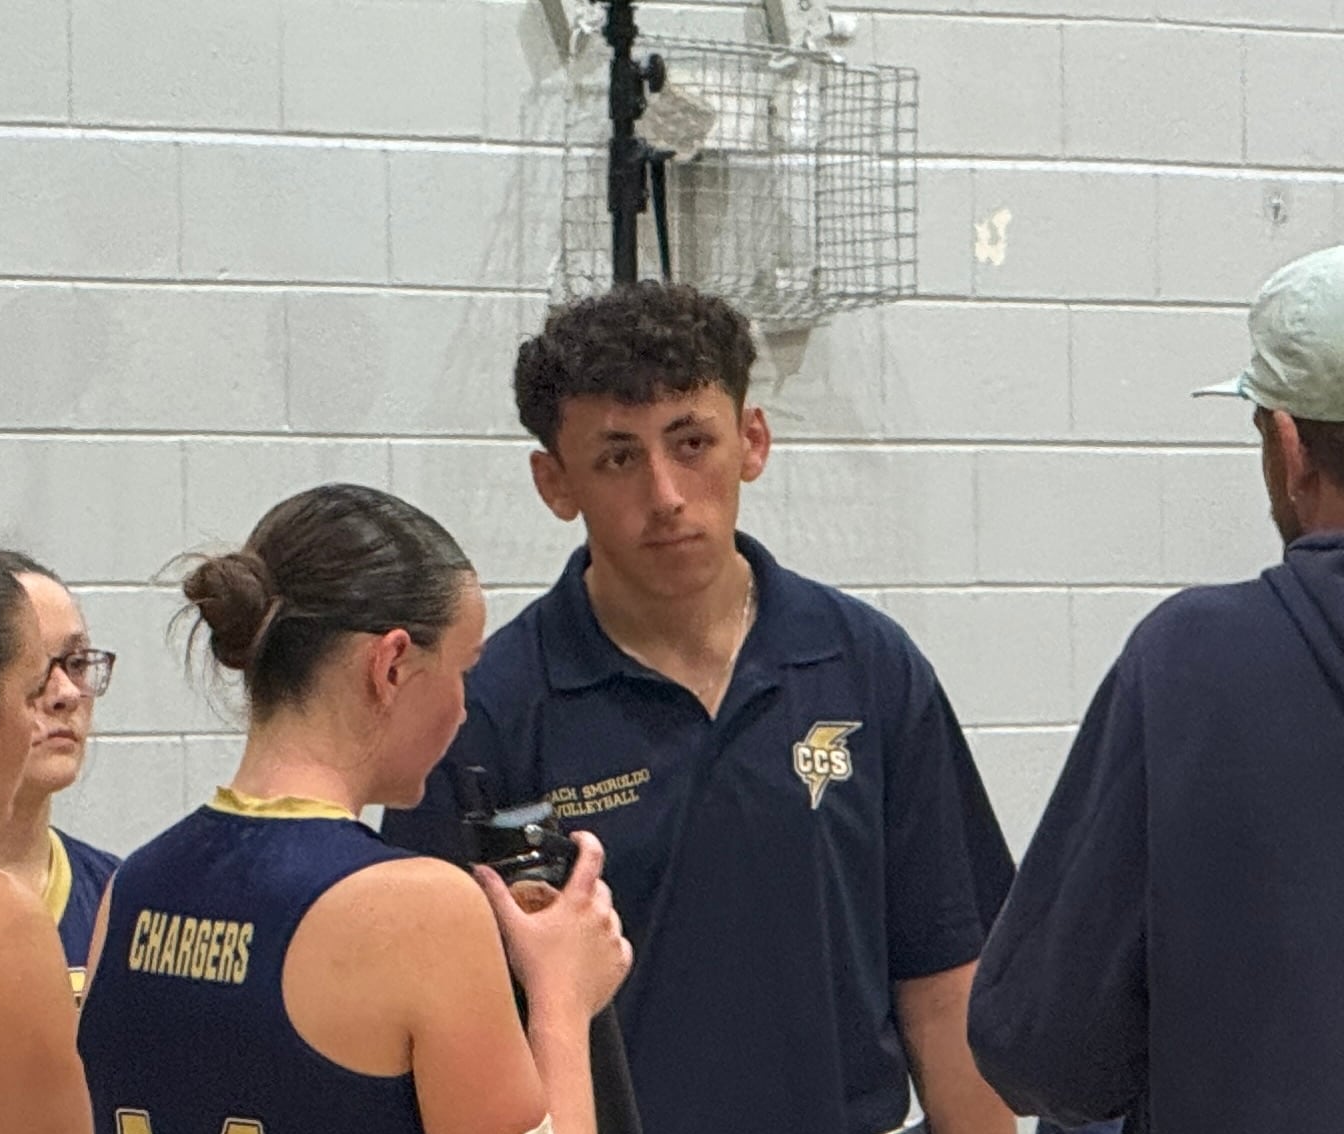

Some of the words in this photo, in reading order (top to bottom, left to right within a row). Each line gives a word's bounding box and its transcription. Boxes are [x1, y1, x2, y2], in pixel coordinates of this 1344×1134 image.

[797, 747, 850, 777] CCS
[553, 788, 641, 819] VOLLEYBALL
[127, 908, 256, 987] CHARGERS
